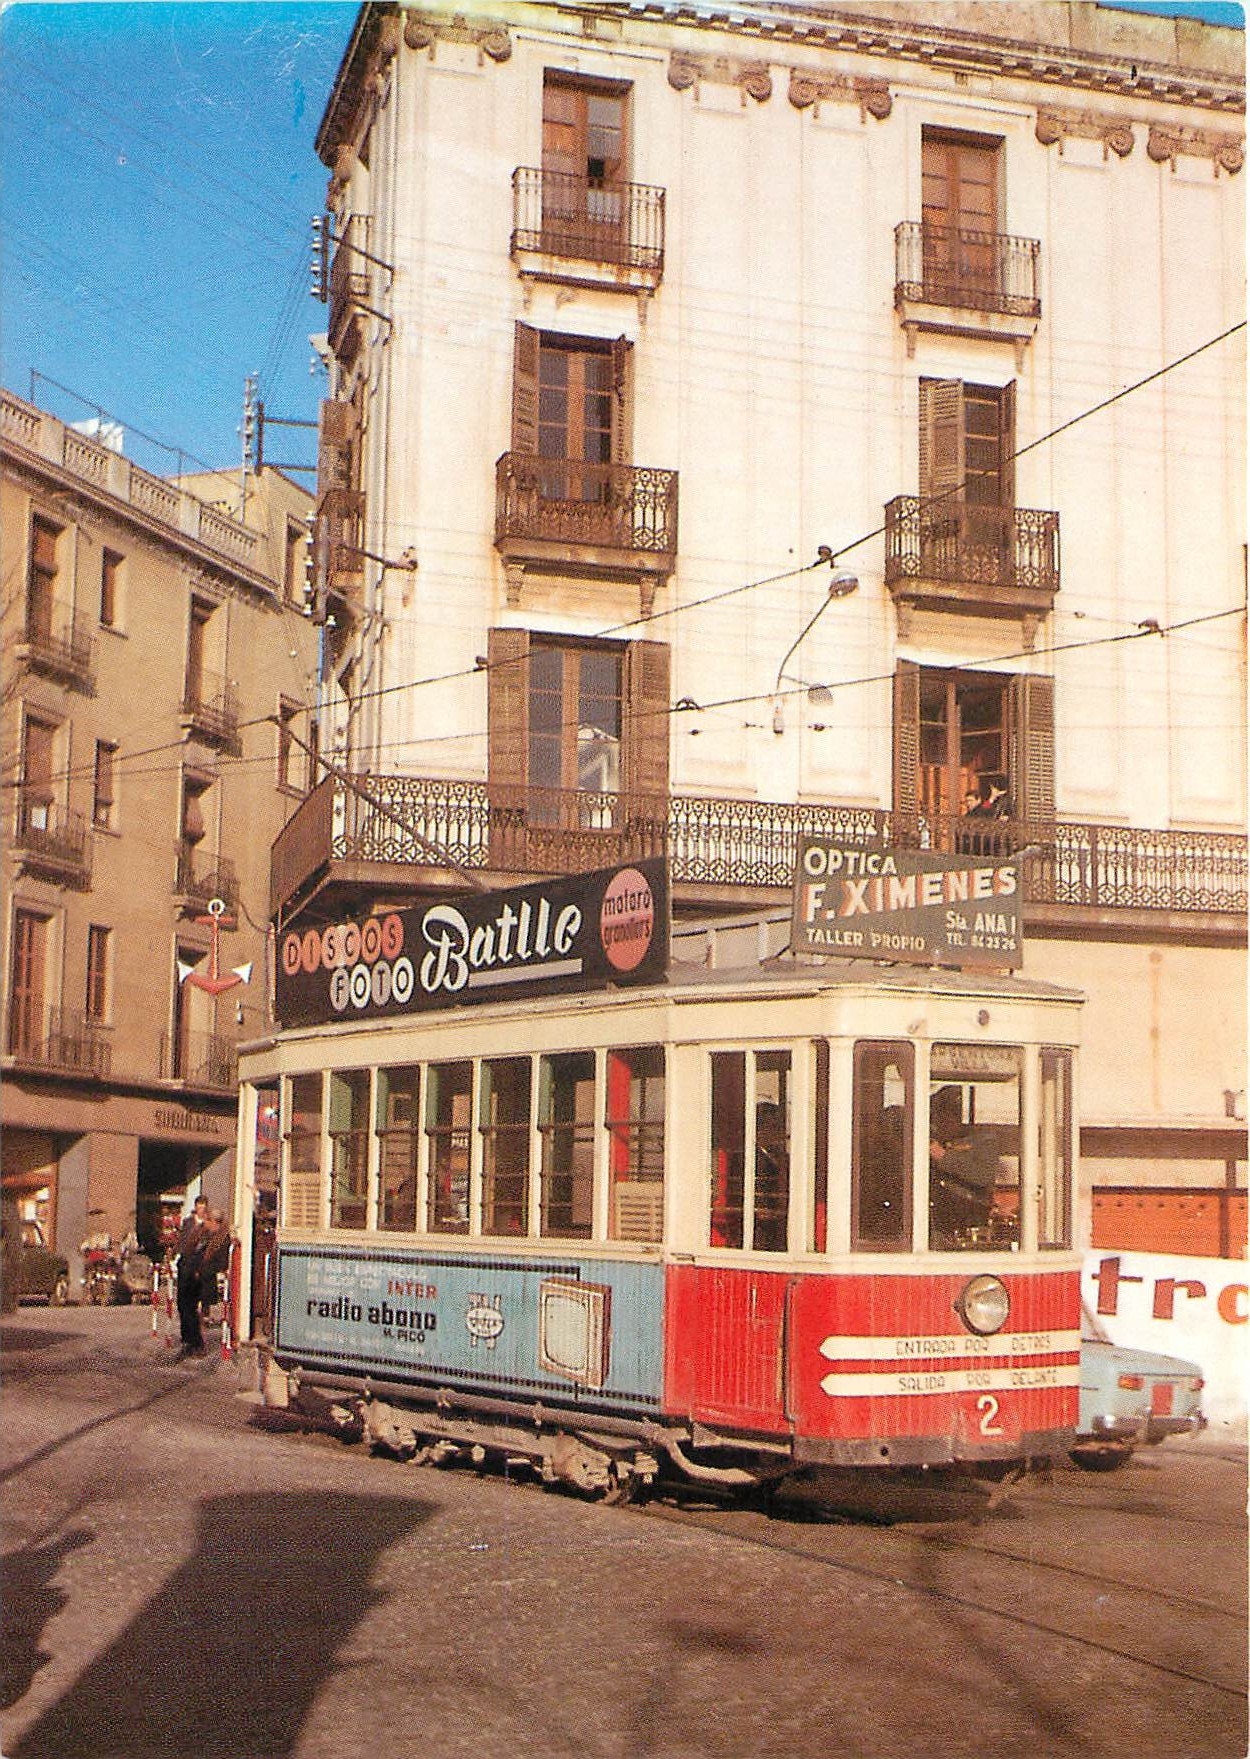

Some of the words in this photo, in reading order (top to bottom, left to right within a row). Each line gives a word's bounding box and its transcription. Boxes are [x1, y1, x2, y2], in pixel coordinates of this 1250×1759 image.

[803, 846, 898, 876] OPTICA
[284, 915, 403, 972] DISCOS
[420, 898, 582, 993] Batlle
[806, 928, 864, 947] TALLER
[871, 932, 925, 951] PROPIO
[331, 958, 413, 1010] FOTO
[386, 1279, 439, 1299] INTER
[306, 1296, 363, 1322] radio
[367, 1301, 438, 1331] abono
[895, 1339, 956, 1357] ENTRADA
[964, 1337, 989, 1352] POR
[898, 1375, 946, 1392] SALIDA
[966, 1372, 992, 1387] POR
[1010, 1369, 1058, 1386] DELANTE
[976, 1393, 1005, 1437] 2
